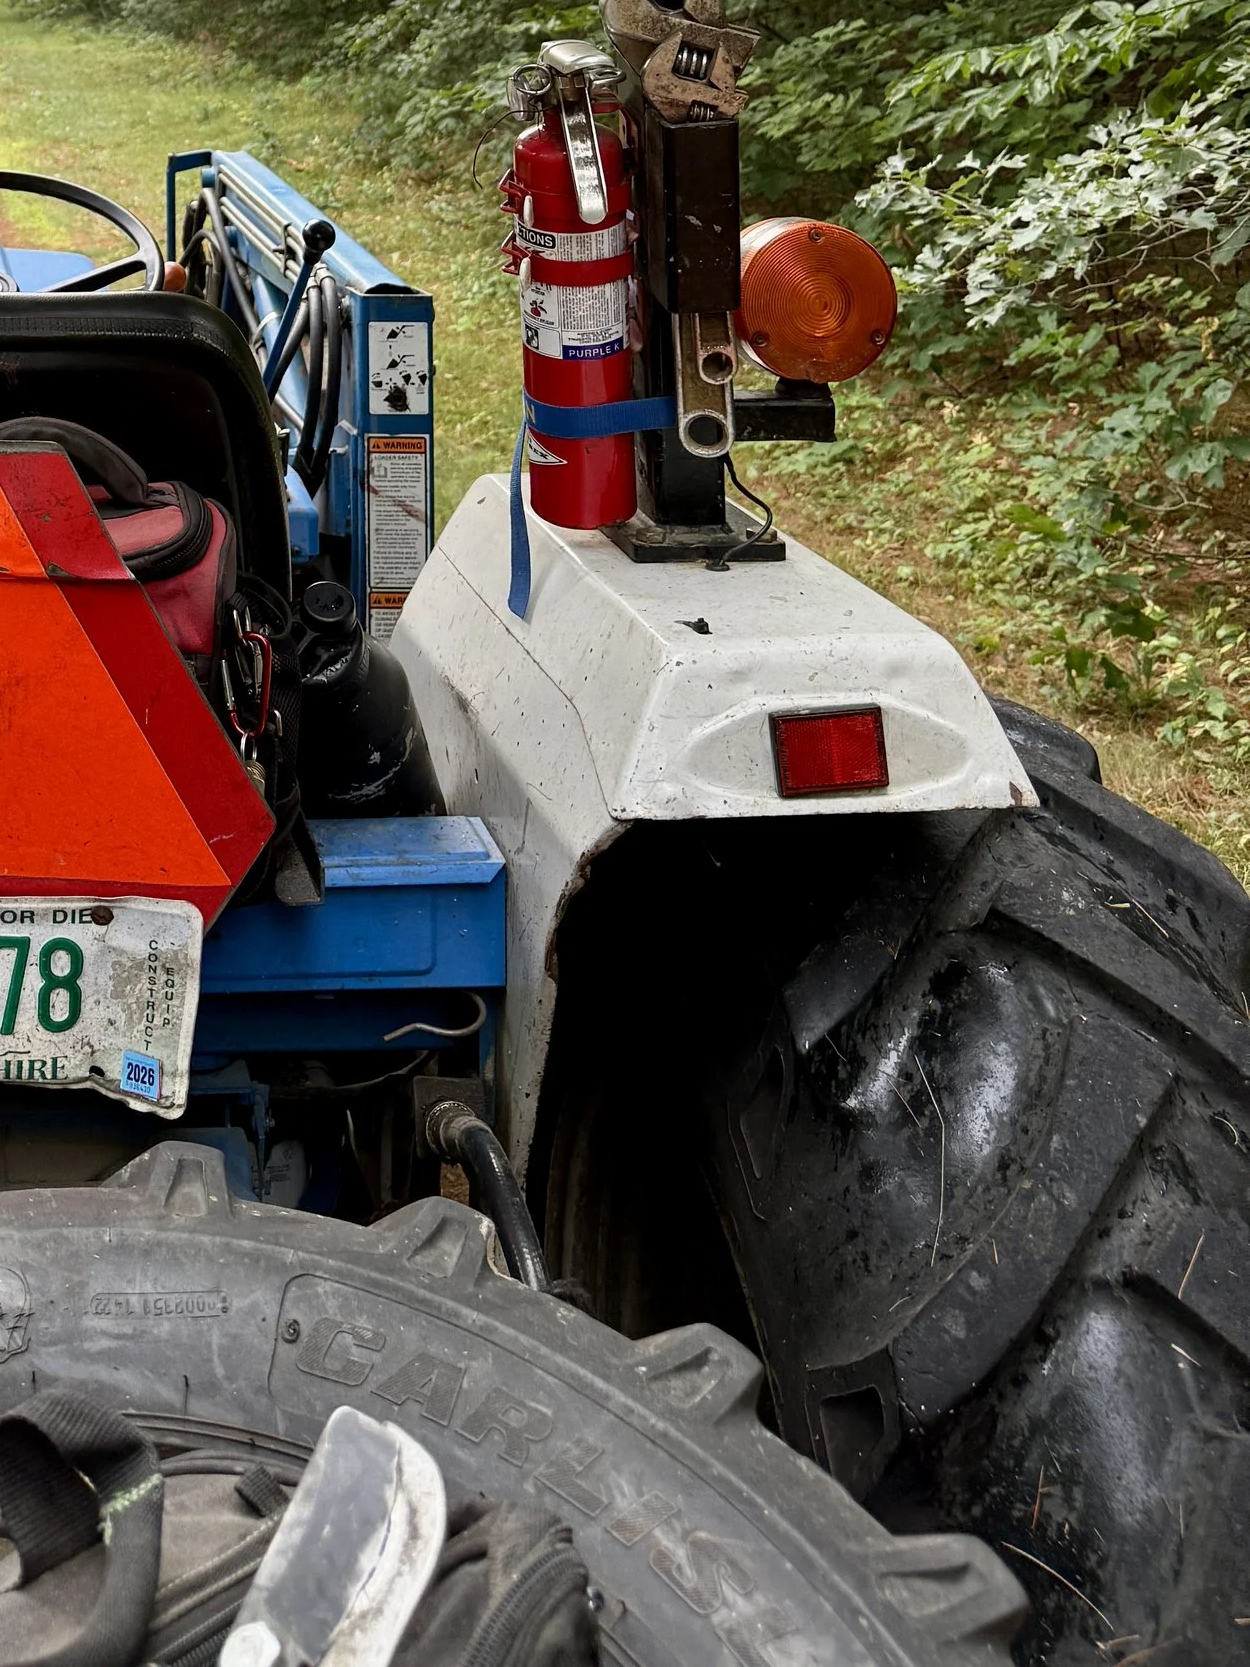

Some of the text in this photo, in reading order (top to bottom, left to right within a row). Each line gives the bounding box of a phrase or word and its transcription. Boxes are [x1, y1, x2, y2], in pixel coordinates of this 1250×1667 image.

[568, 342, 620, 359] PURPLE K
[382, 440, 423, 451] WARNING
[0, 908, 38, 925] OR
[52, 909, 94, 926] DIE
[143, 939, 159, 1052] CONSTRUCT
[163, 967, 176, 1028] EQUIP
[126, 1061, 155, 1087] 2026
[296, 1316, 799, 1667] CARLISL
